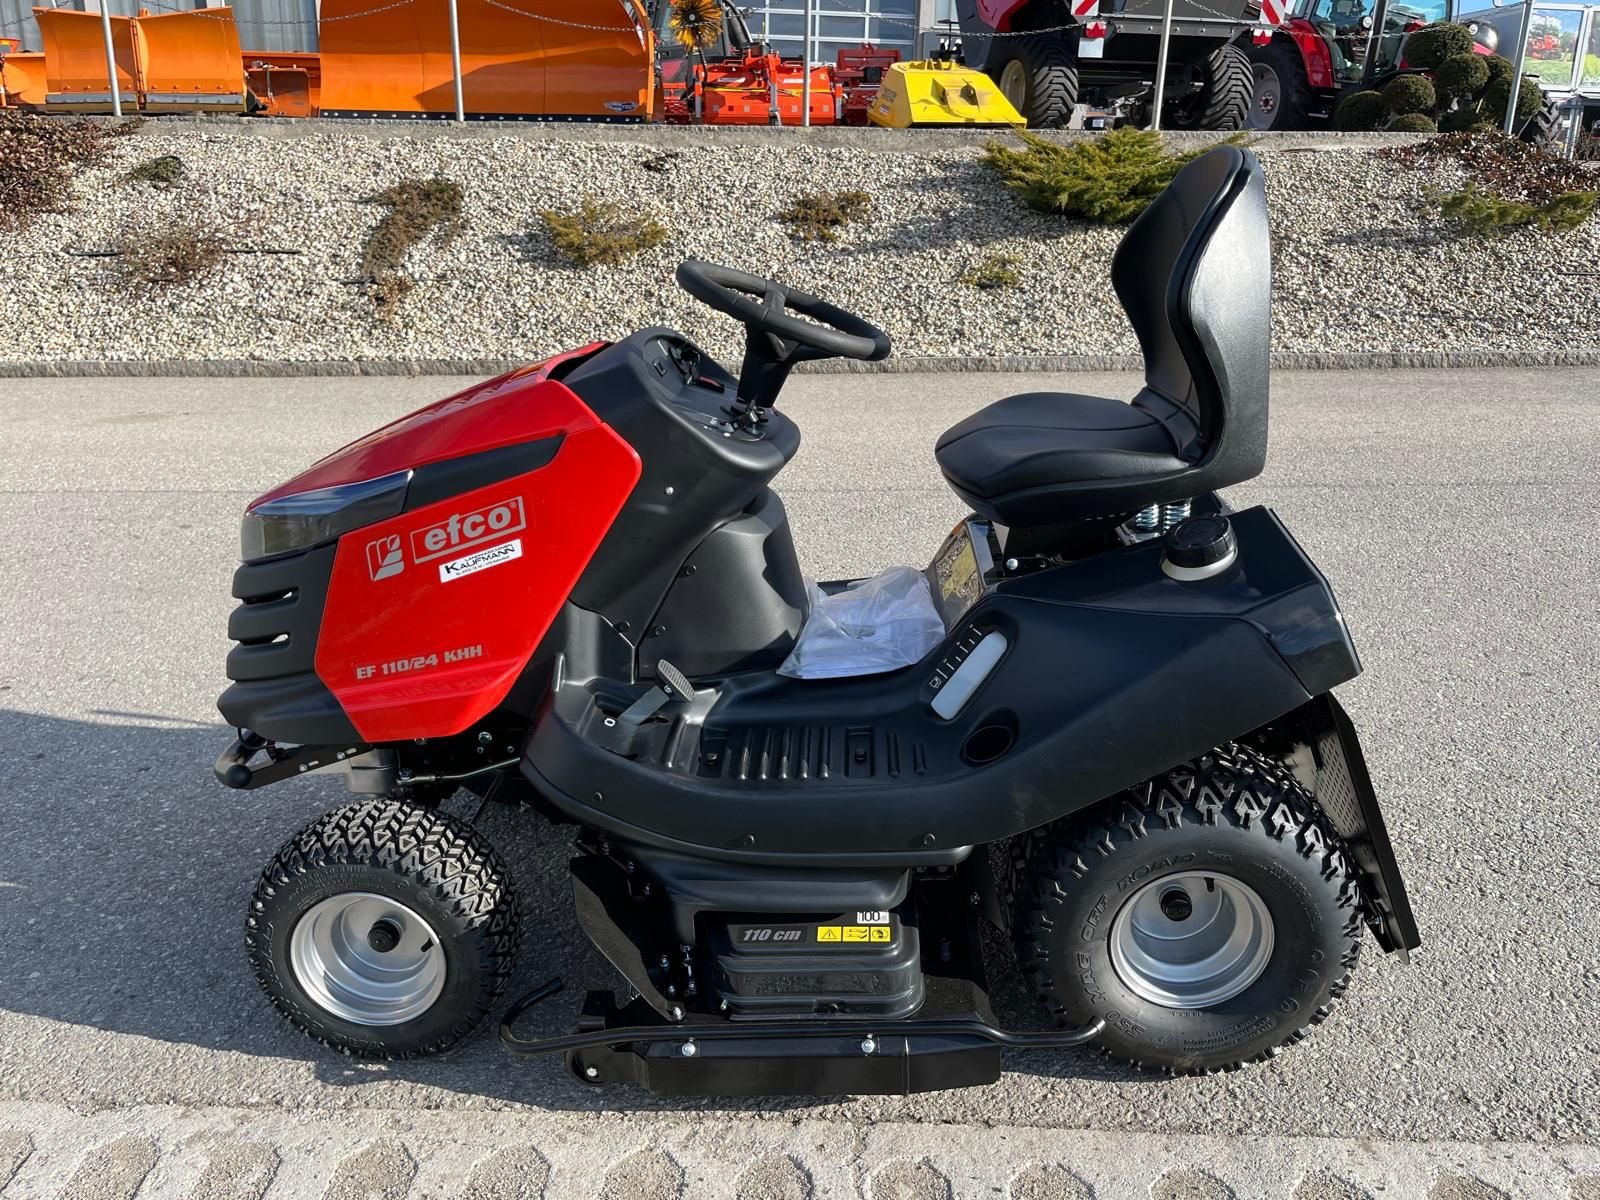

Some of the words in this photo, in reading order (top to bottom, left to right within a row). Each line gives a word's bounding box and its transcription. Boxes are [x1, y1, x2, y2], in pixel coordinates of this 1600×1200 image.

[424, 507, 512, 551] efco
[356, 665, 377, 680] EF
[382, 653, 439, 676] 110/24
[444, 644, 483, 664] KHH
[743, 929, 772, 941] 110
[773, 930, 802, 941] cm
[1080, 893, 1108, 943] OFF
